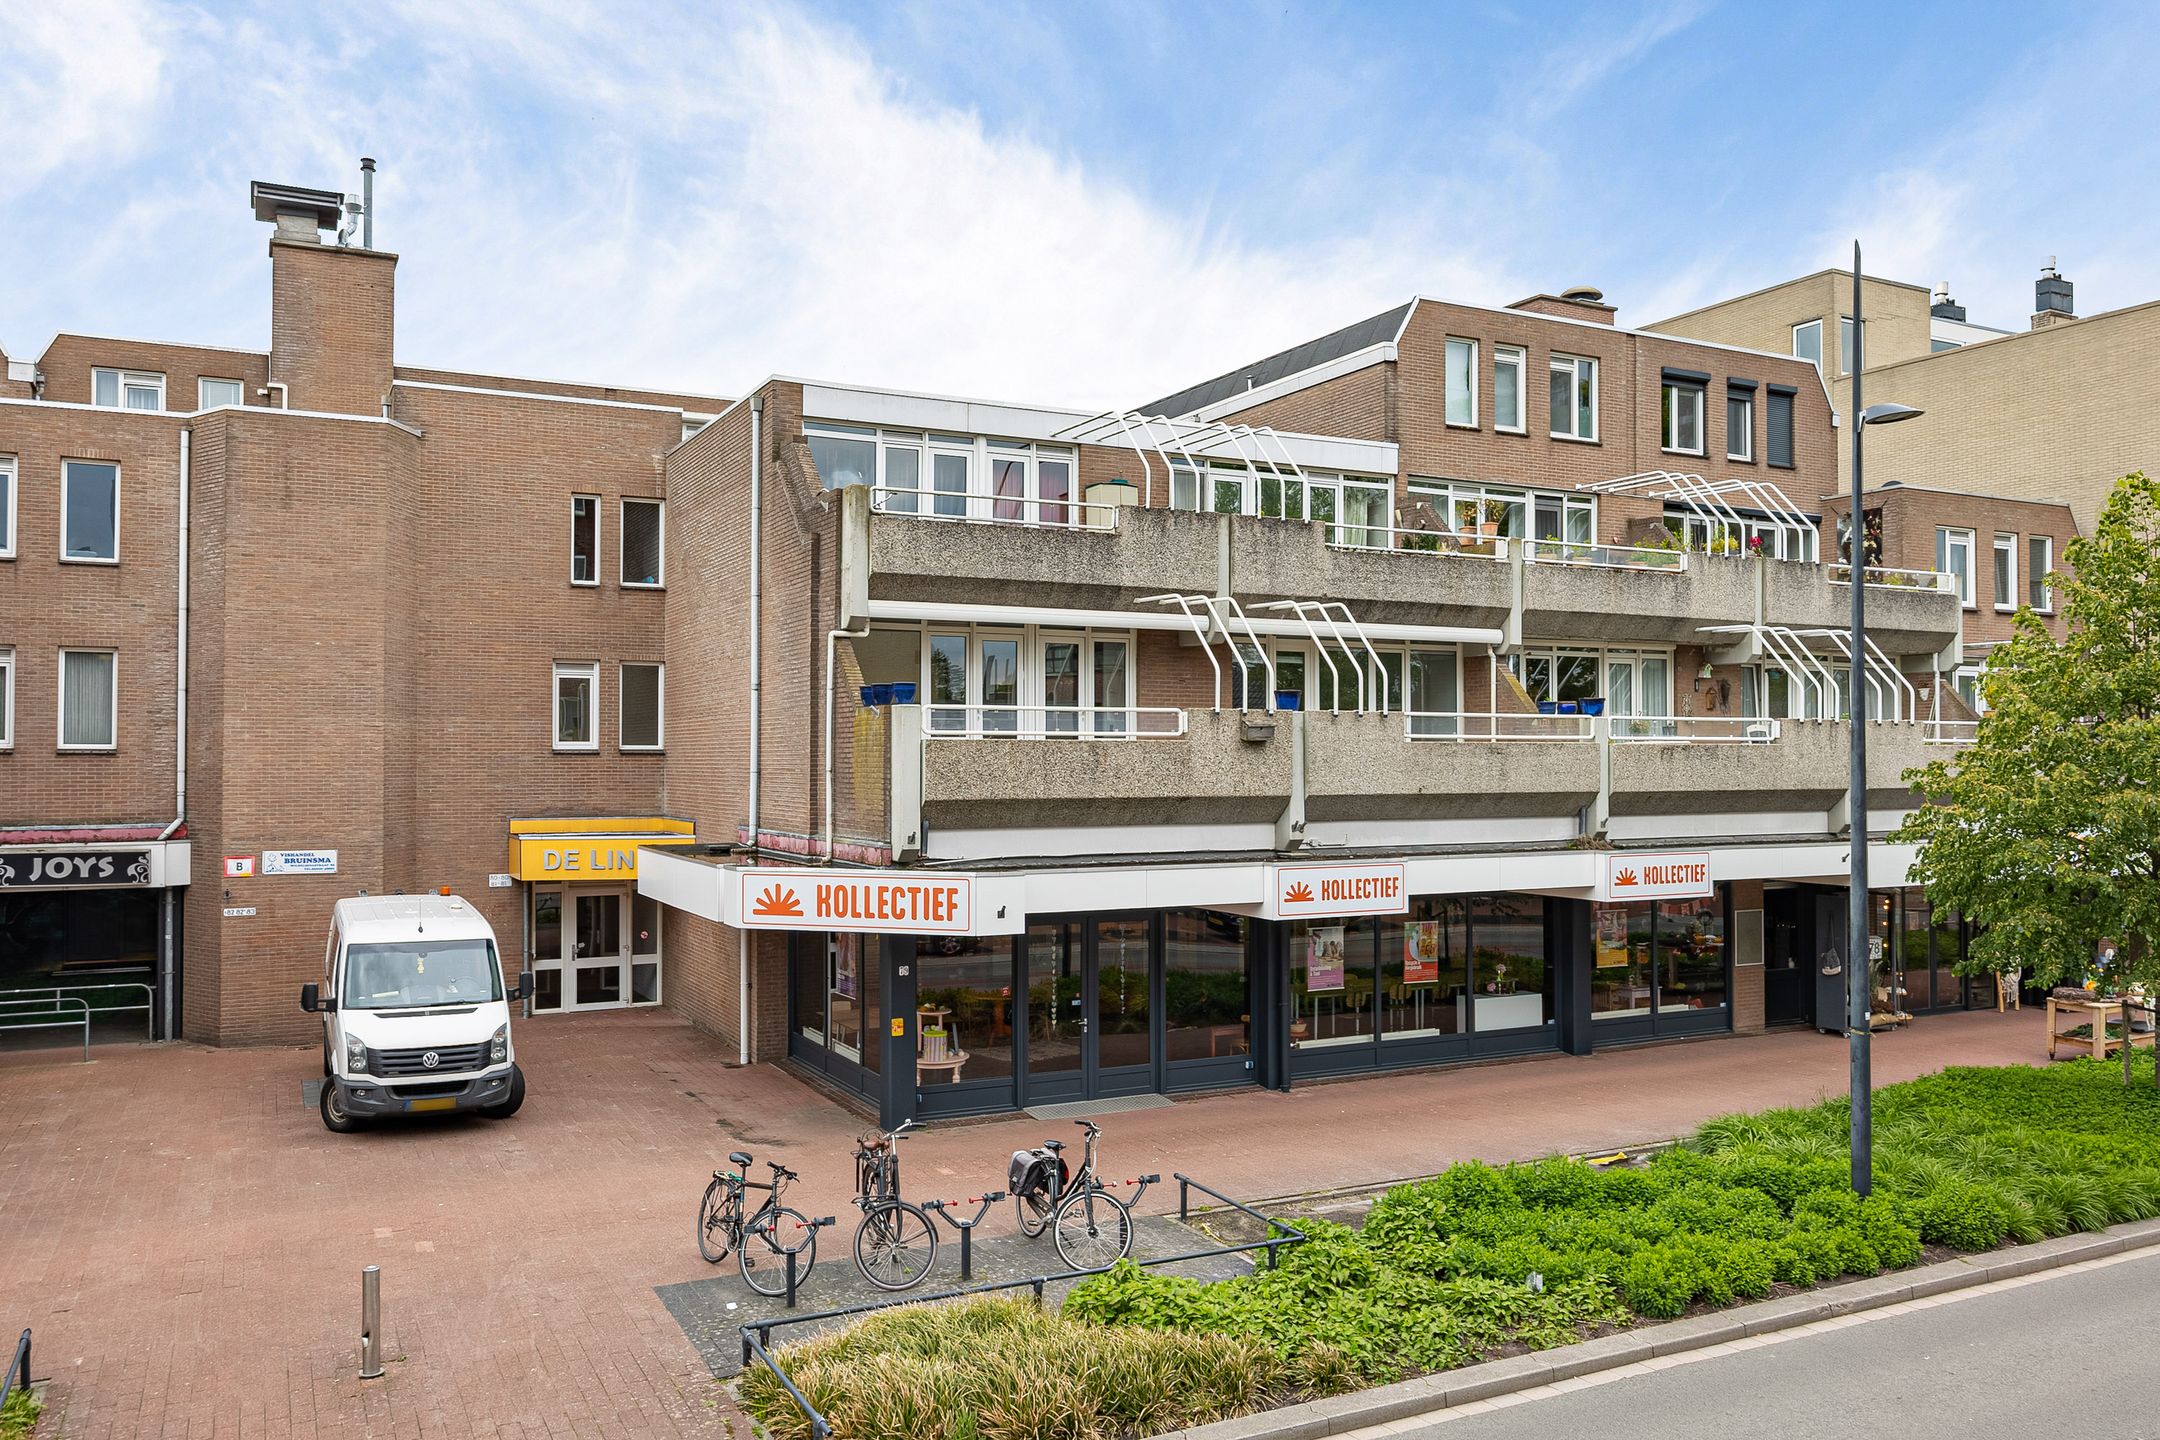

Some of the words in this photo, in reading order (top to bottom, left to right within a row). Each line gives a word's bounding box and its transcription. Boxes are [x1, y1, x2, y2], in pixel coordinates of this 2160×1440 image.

[28, 856, 115, 882] JOYS
[236, 862, 243, 871] B
[543, 849, 580, 870] DE
[590, 849, 634, 870] LIN
[1643, 863, 1706, 885] KOLLECTIEF
[1321, 877, 1399, 901] KOLLECTIEF
[816, 884, 959, 922] KOLLECTIEF
[1869, 942, 1880, 955] 78
